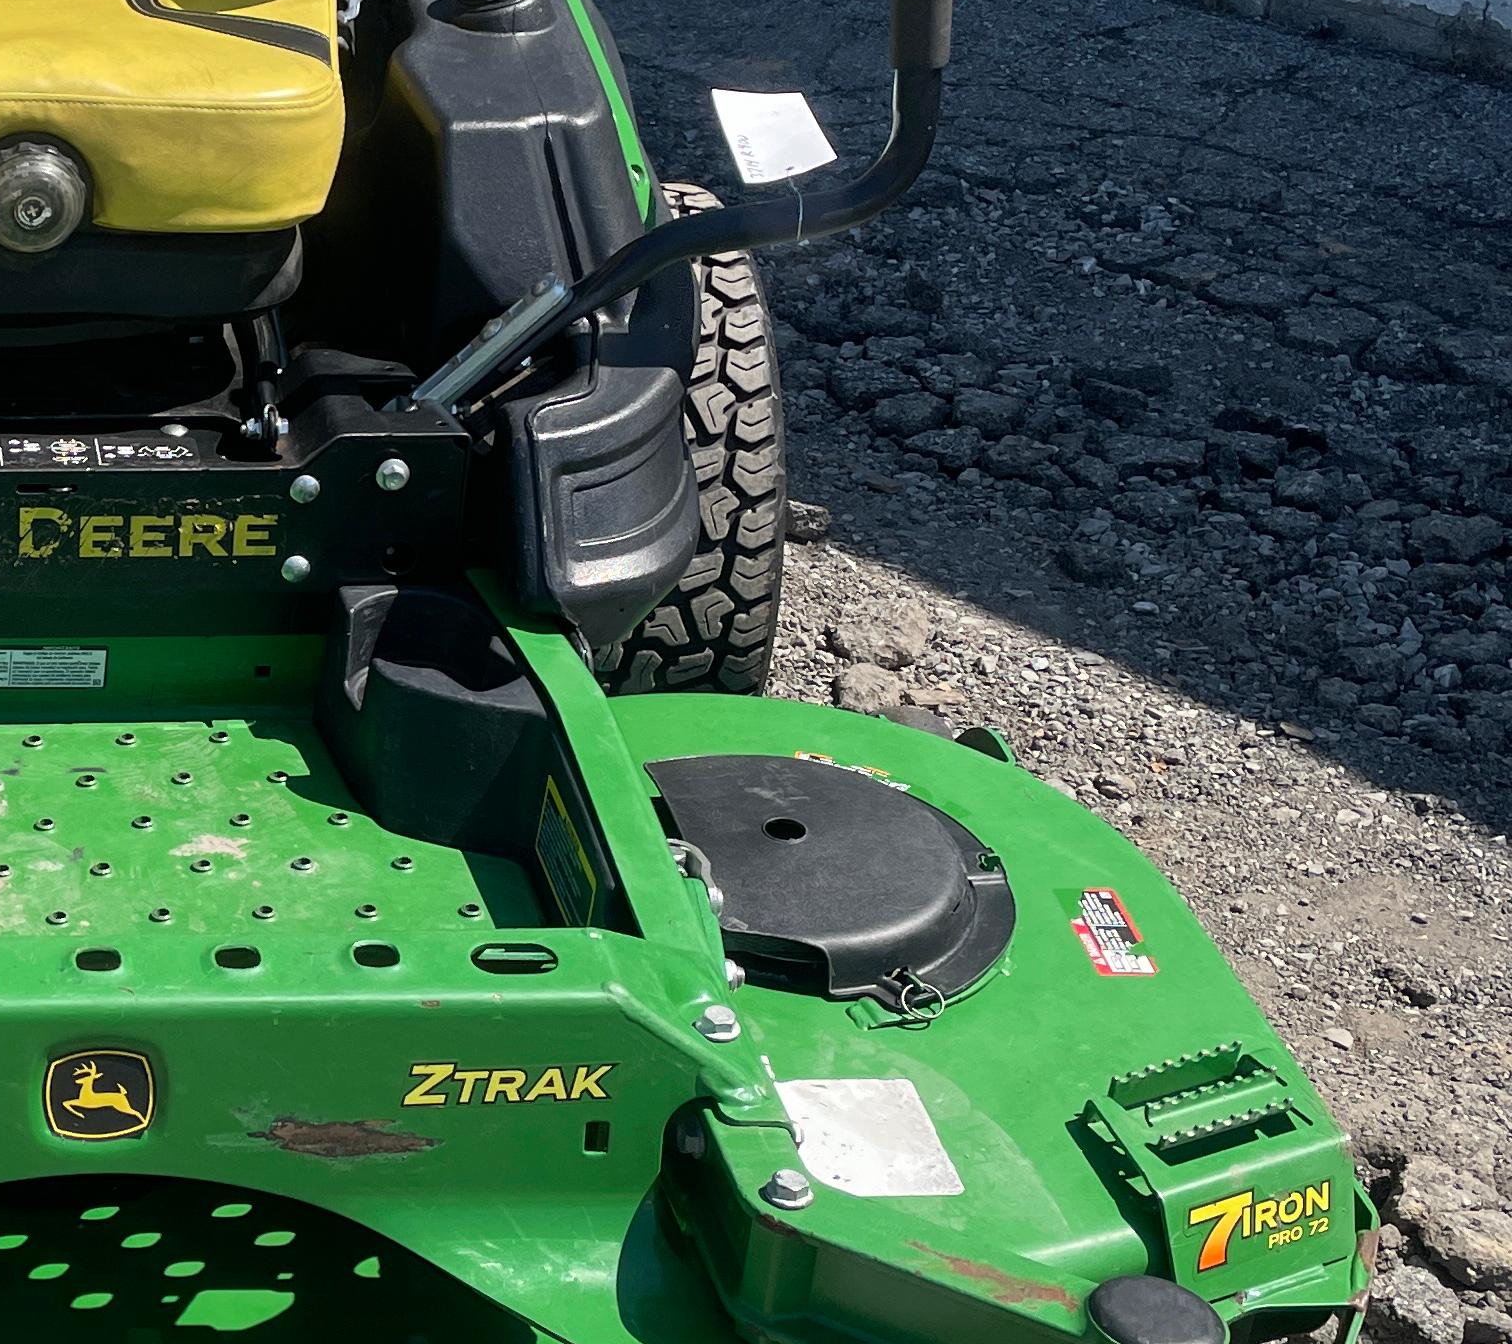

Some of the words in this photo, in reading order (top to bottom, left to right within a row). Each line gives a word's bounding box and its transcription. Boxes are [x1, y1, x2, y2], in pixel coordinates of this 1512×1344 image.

[18, 507, 279, 559] DEERE
[402, 1063, 615, 1106] ZTRAK
[1267, 1225, 1304, 1250] PRO
[1308, 1217, 1330, 1237] 72
